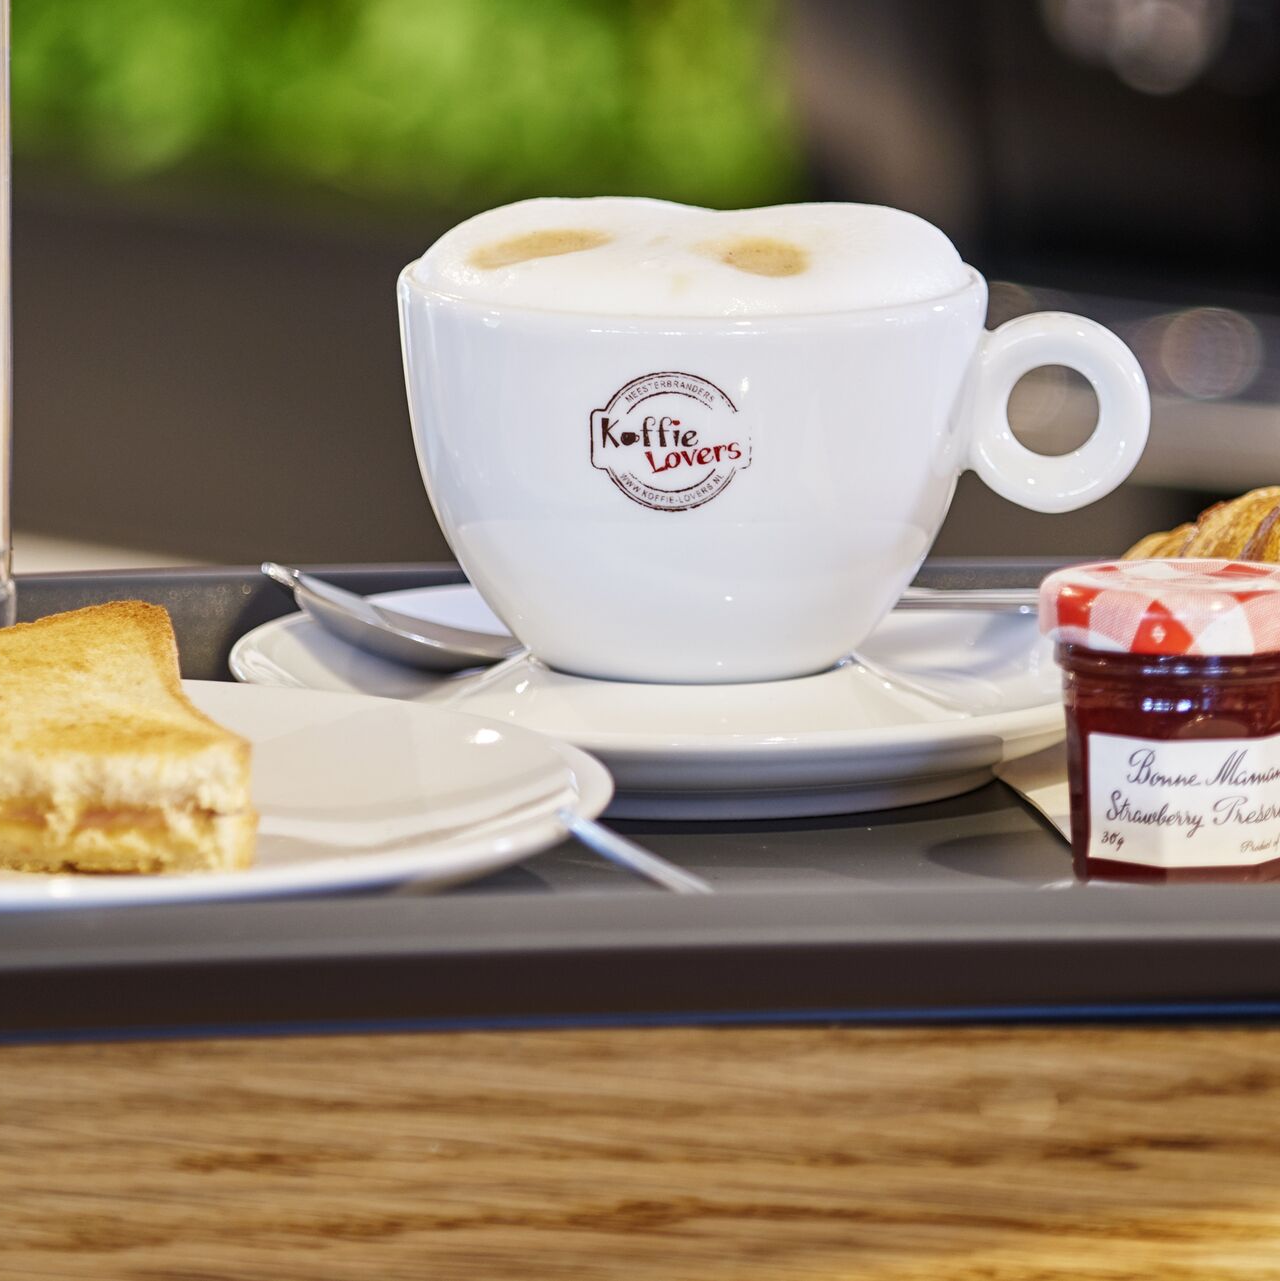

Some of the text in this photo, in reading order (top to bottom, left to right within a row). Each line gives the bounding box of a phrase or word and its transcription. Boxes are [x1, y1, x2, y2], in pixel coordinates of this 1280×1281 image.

[625, 380, 715, 403] MEESTERBRANDERS
[601, 416, 698, 448] Koffie
[645, 442, 741, 474] Lovers
[1127, 748, 1200, 786] Bonne
[1106, 790, 1204, 838] Strawberry
